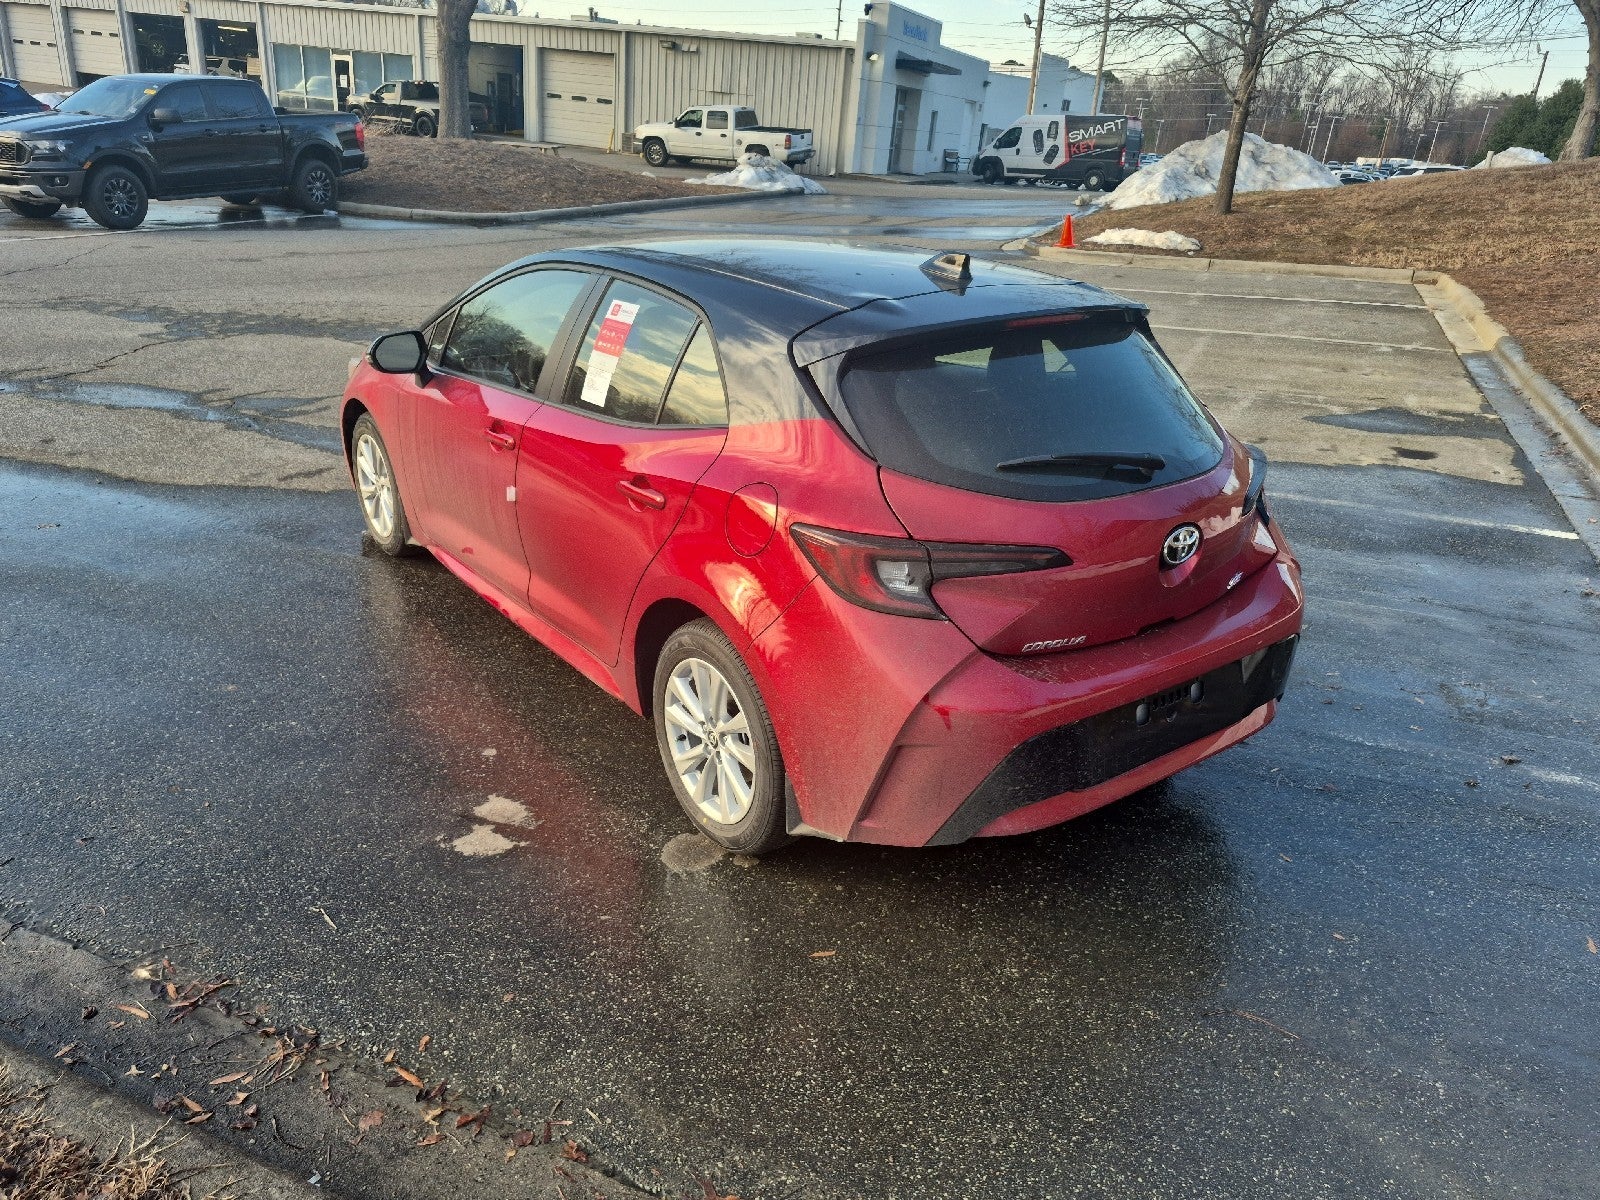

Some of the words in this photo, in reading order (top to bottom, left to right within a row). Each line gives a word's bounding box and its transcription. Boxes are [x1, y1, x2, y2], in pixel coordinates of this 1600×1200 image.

[1069, 118, 1125, 142] SMART
[1071, 139, 1096, 154] KEY
[1022, 635, 1086, 652] COROLLA
